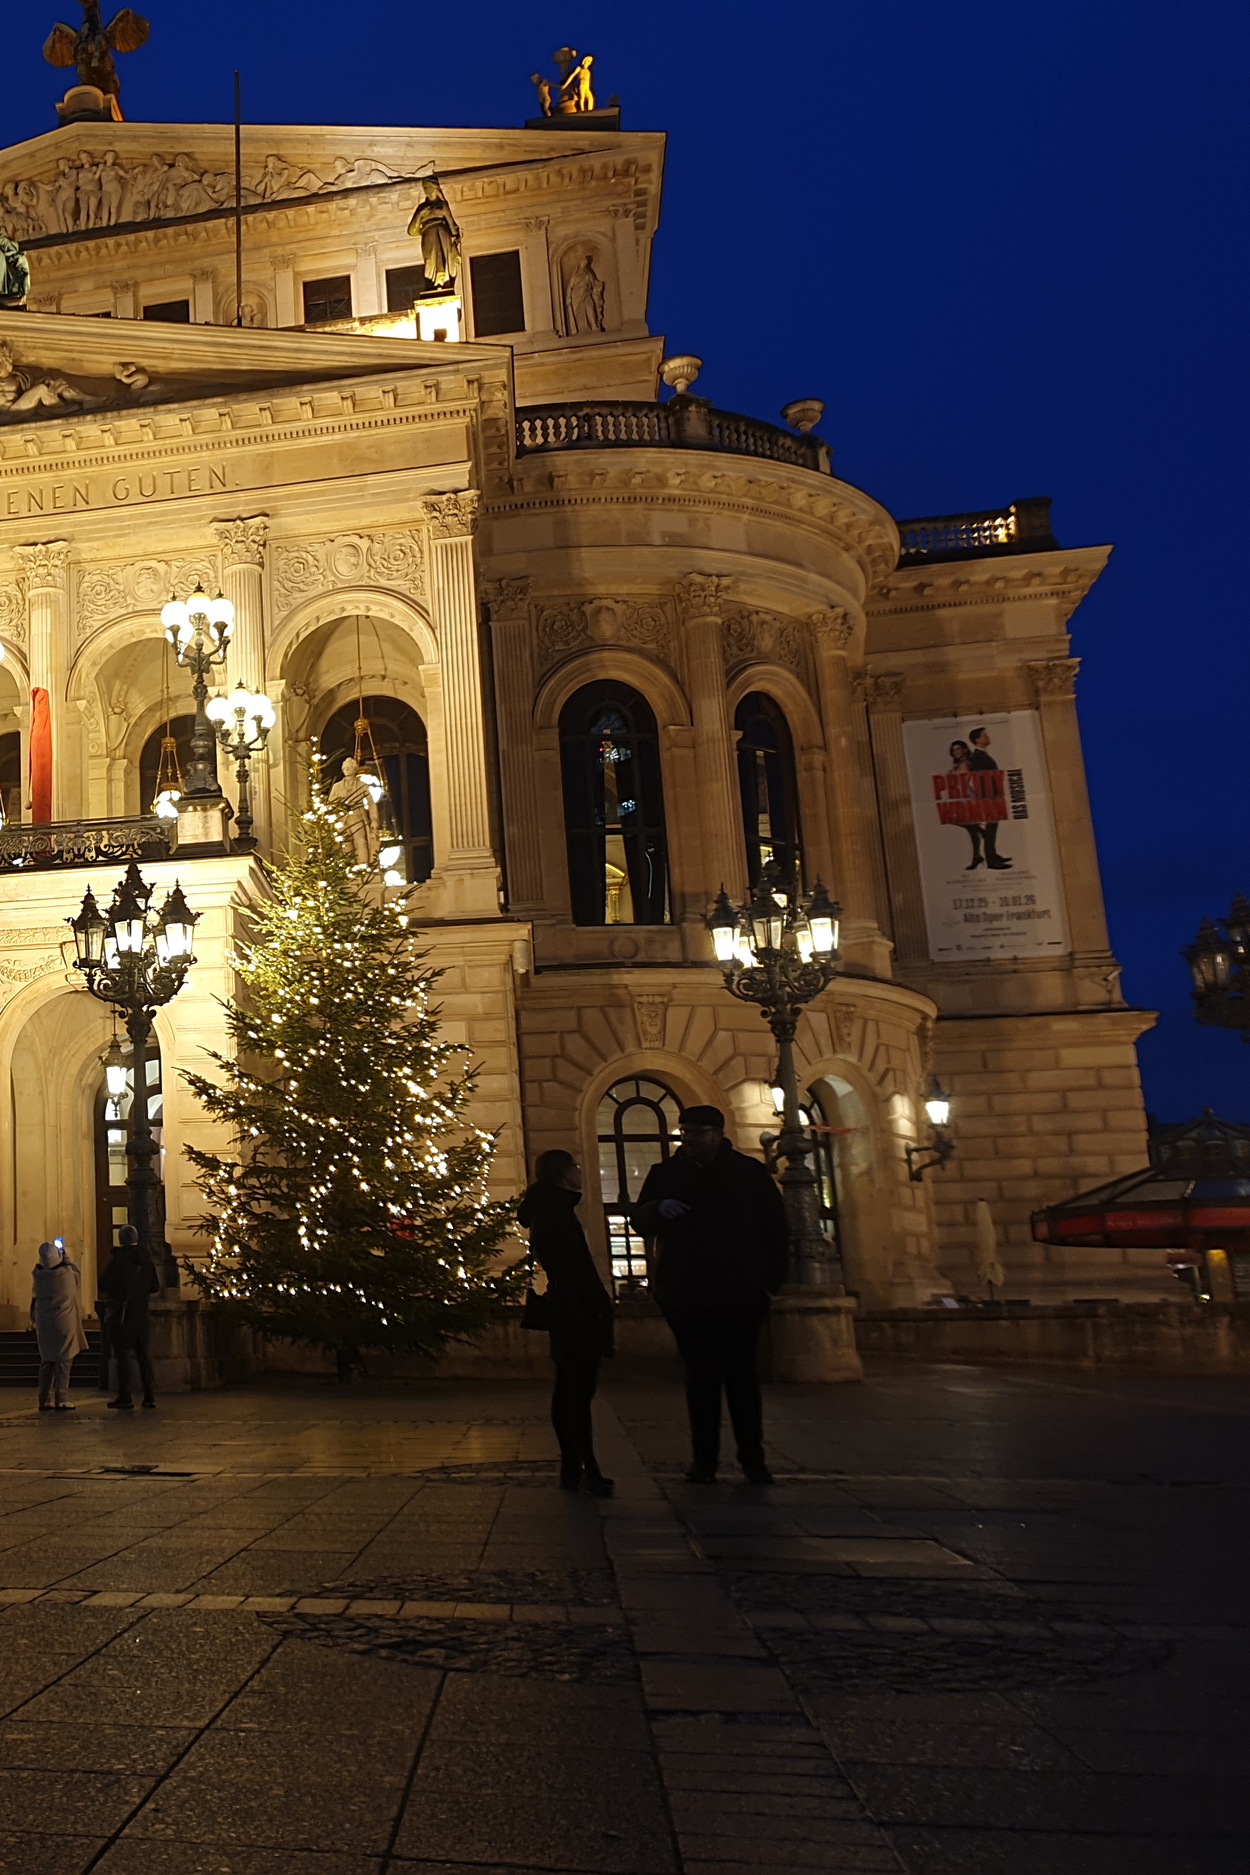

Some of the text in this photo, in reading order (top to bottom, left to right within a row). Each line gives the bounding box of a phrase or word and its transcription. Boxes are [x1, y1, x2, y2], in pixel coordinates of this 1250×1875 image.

[932, 770, 1005, 801] PRETTY
[1007, 768, 1028, 820] DAS MUSICAL
[1006, 908, 1052, 921] Frankfurt
